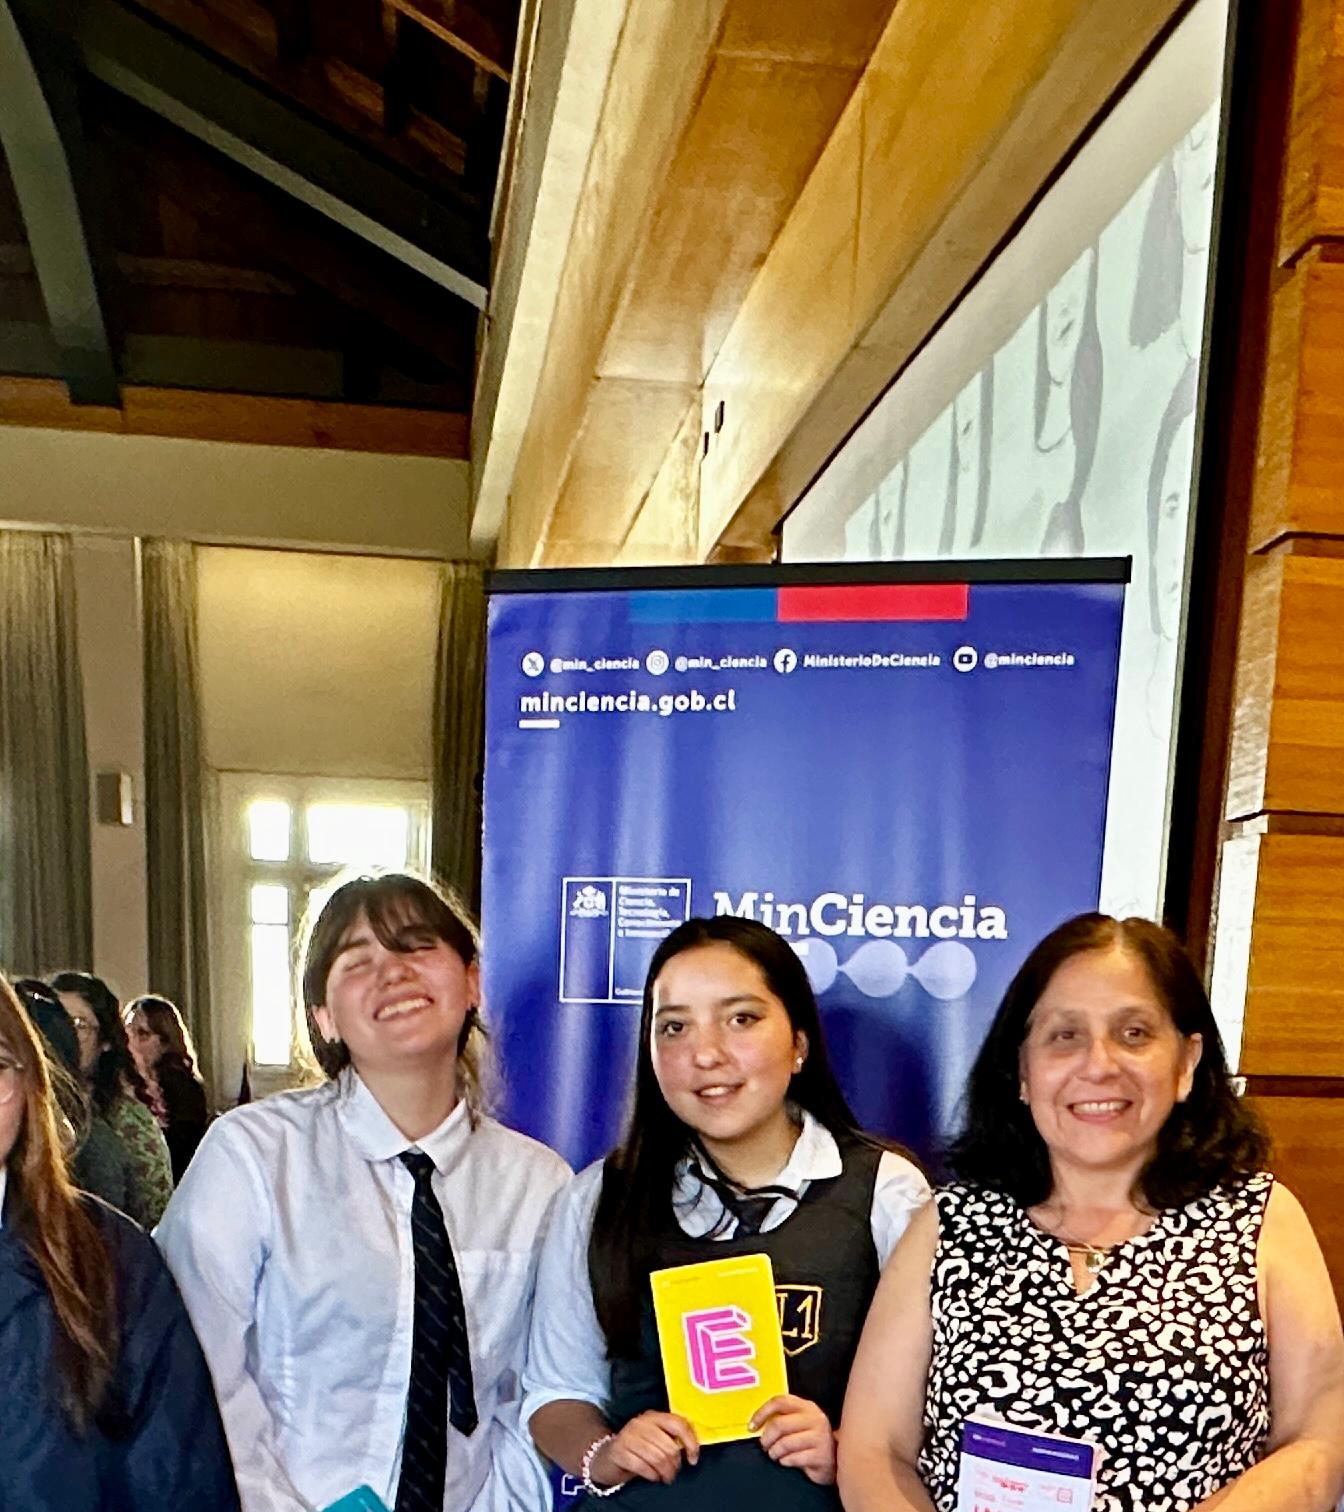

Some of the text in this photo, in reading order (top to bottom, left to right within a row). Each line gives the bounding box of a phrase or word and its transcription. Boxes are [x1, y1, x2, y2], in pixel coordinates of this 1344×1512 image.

[550, 652, 1075, 674] @min_ciencia @min_ciencia MinisterioDeCiencia @minciencia
[520, 689, 736, 717] minciencia.gob.cl
[713, 892, 1008, 940] MinCiencia
[682, 1304, 760, 1394] E
